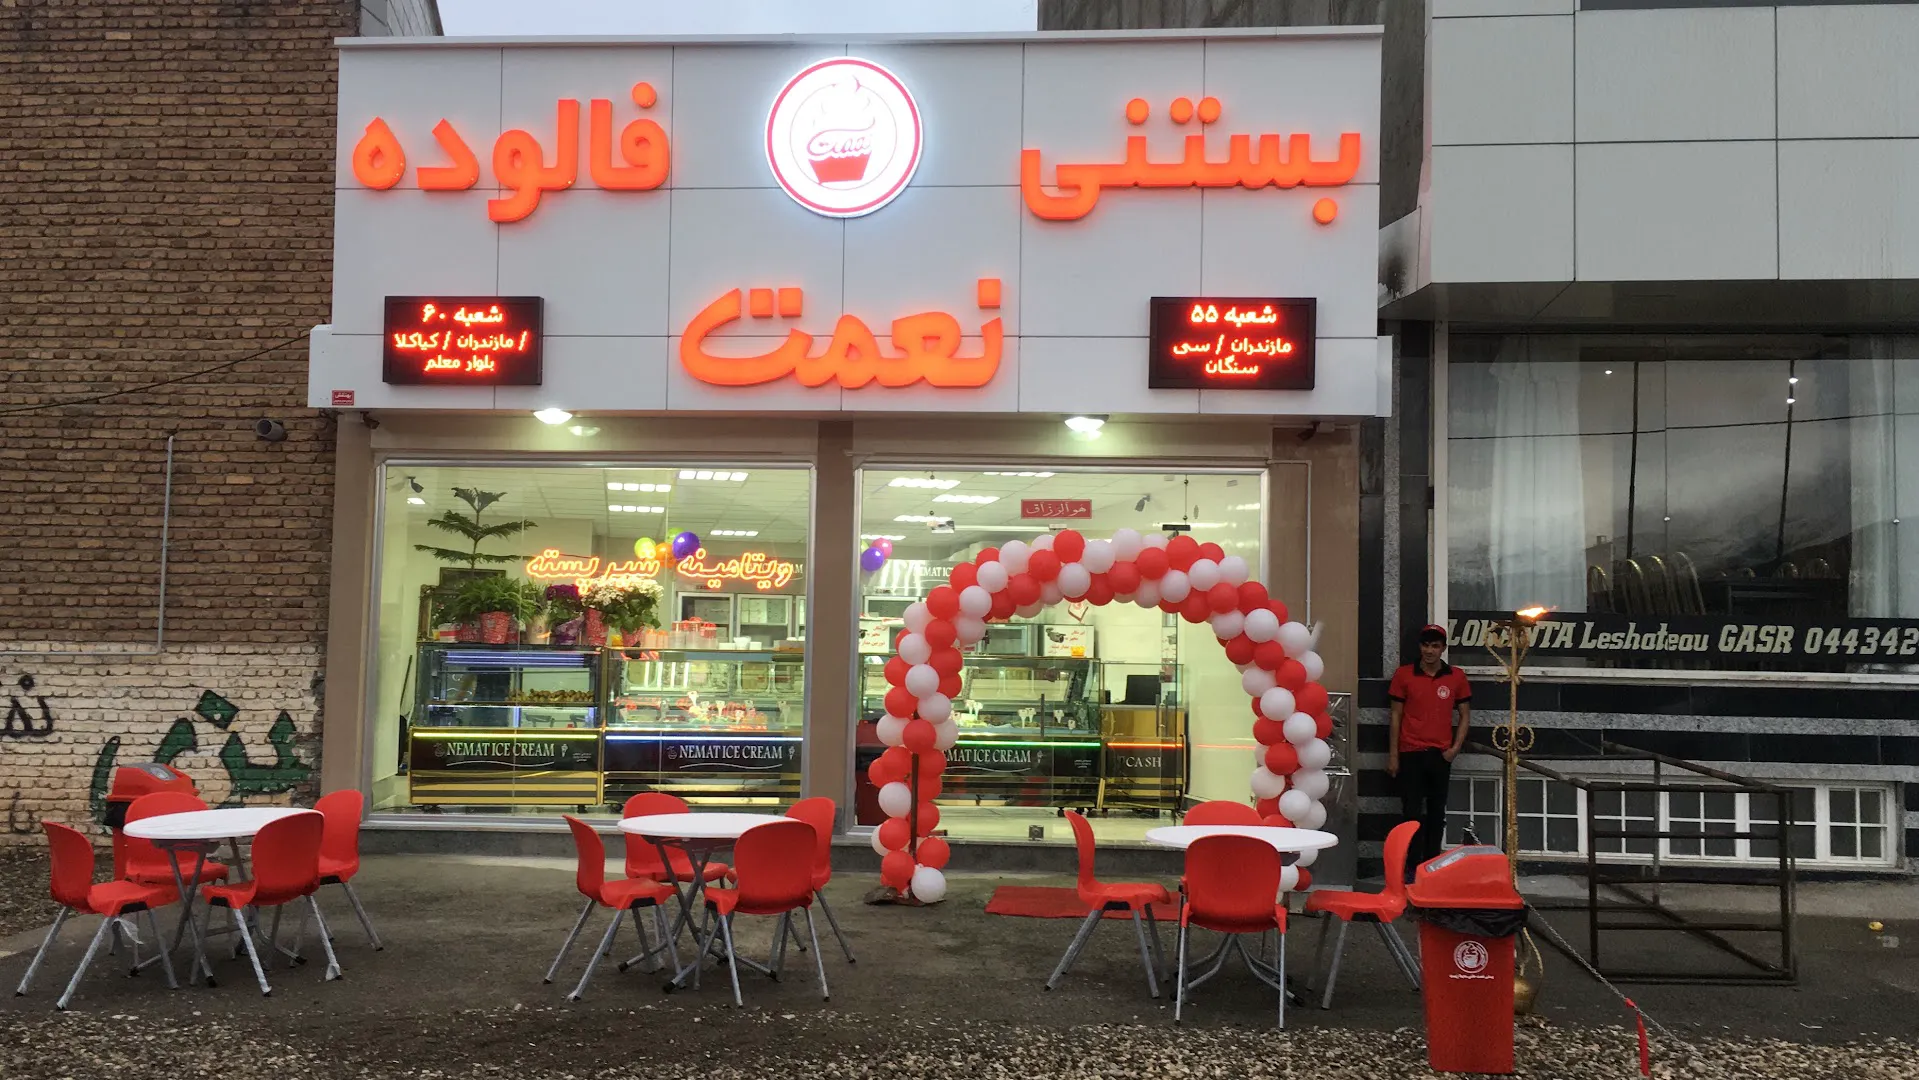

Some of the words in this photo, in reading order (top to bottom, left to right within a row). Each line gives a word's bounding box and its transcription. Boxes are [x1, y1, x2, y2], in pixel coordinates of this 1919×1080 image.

[353, 82, 670, 222] فالوده
[1020, 97, 1360, 224] بستنی
[453, 305, 503, 326] شعبه
[1191, 304, 1219, 323] ۵۵
[1224, 305, 1277, 327] شعبه
[456, 333, 514, 351] مازندران
[679, 278, 1003, 389] نعمت
[1173, 342, 1210, 355] سی
[1230, 337, 1292, 355] مازندران
[424, 354, 461, 371] معلم
[465, 354, 495, 372] بلوار
[1205, 355, 1259, 374] سنگان
[677, 548, 793, 589] ویتامینه
[1578, 621, 1710, 652] Leshateau
[1717, 624, 1795, 654] GASR
[446, 742, 490, 757] NEMAT
[491, 742, 511, 757] ICE
[513, 743, 555, 757] CREAM
[679, 744, 721, 759] NEMAT
[722, 745, 741, 759] ICE
[742, 745, 783, 759] CREAM
[973, 748, 991, 762] ICE
[992, 749, 1031, 763] CREAM
[1125, 756, 1162, 768] CASH
